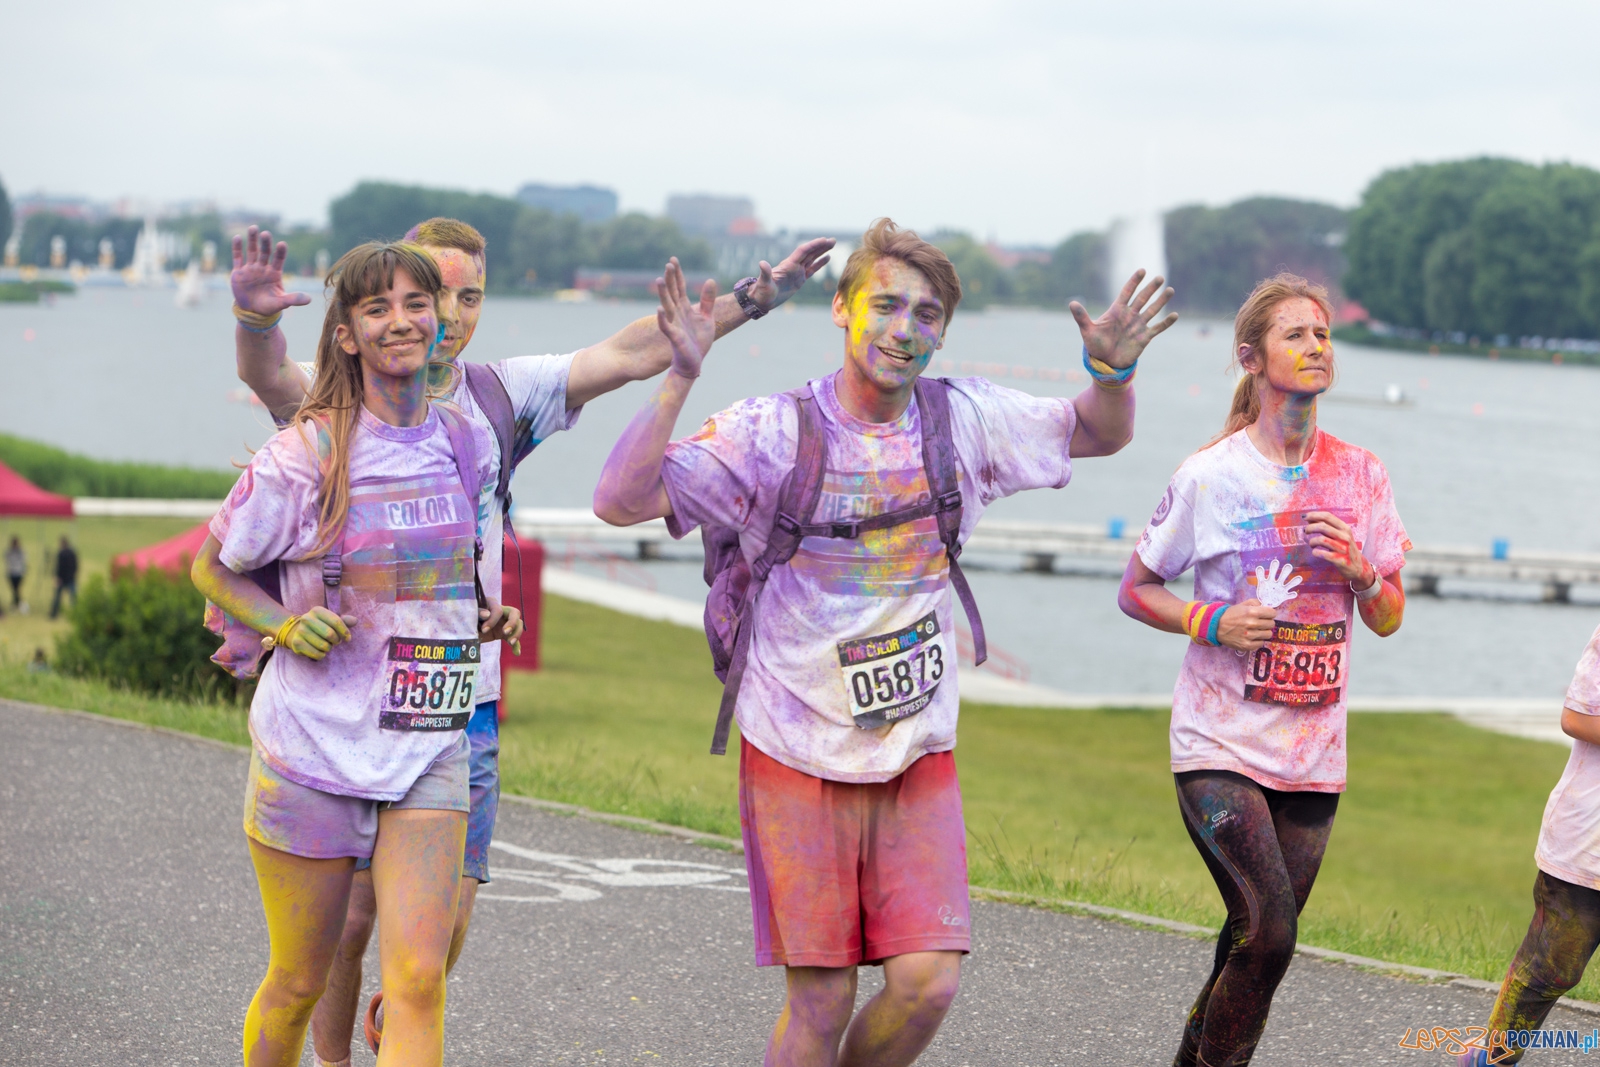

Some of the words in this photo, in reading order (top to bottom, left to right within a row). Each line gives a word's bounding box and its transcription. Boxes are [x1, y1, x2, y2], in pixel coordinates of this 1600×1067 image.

[348, 502, 389, 533] THE
[388, 496, 452, 527] COLOR
[846, 643, 868, 662] THE
[866, 638, 900, 659] COLOR
[899, 630, 919, 649] RUN
[1277, 627, 1309, 642] COLOR
[396, 643, 414, 659] THE
[414, 644, 446, 660] COLOR
[445, 646, 461, 660] RUN
[1253, 647, 1342, 687] 05853
[389, 668, 475, 710] 05875
[851, 643, 944, 708] 05873
[410, 716, 454, 728] #HAPPIEST5K
[885, 693, 930, 720] #HAPPIEST5K
